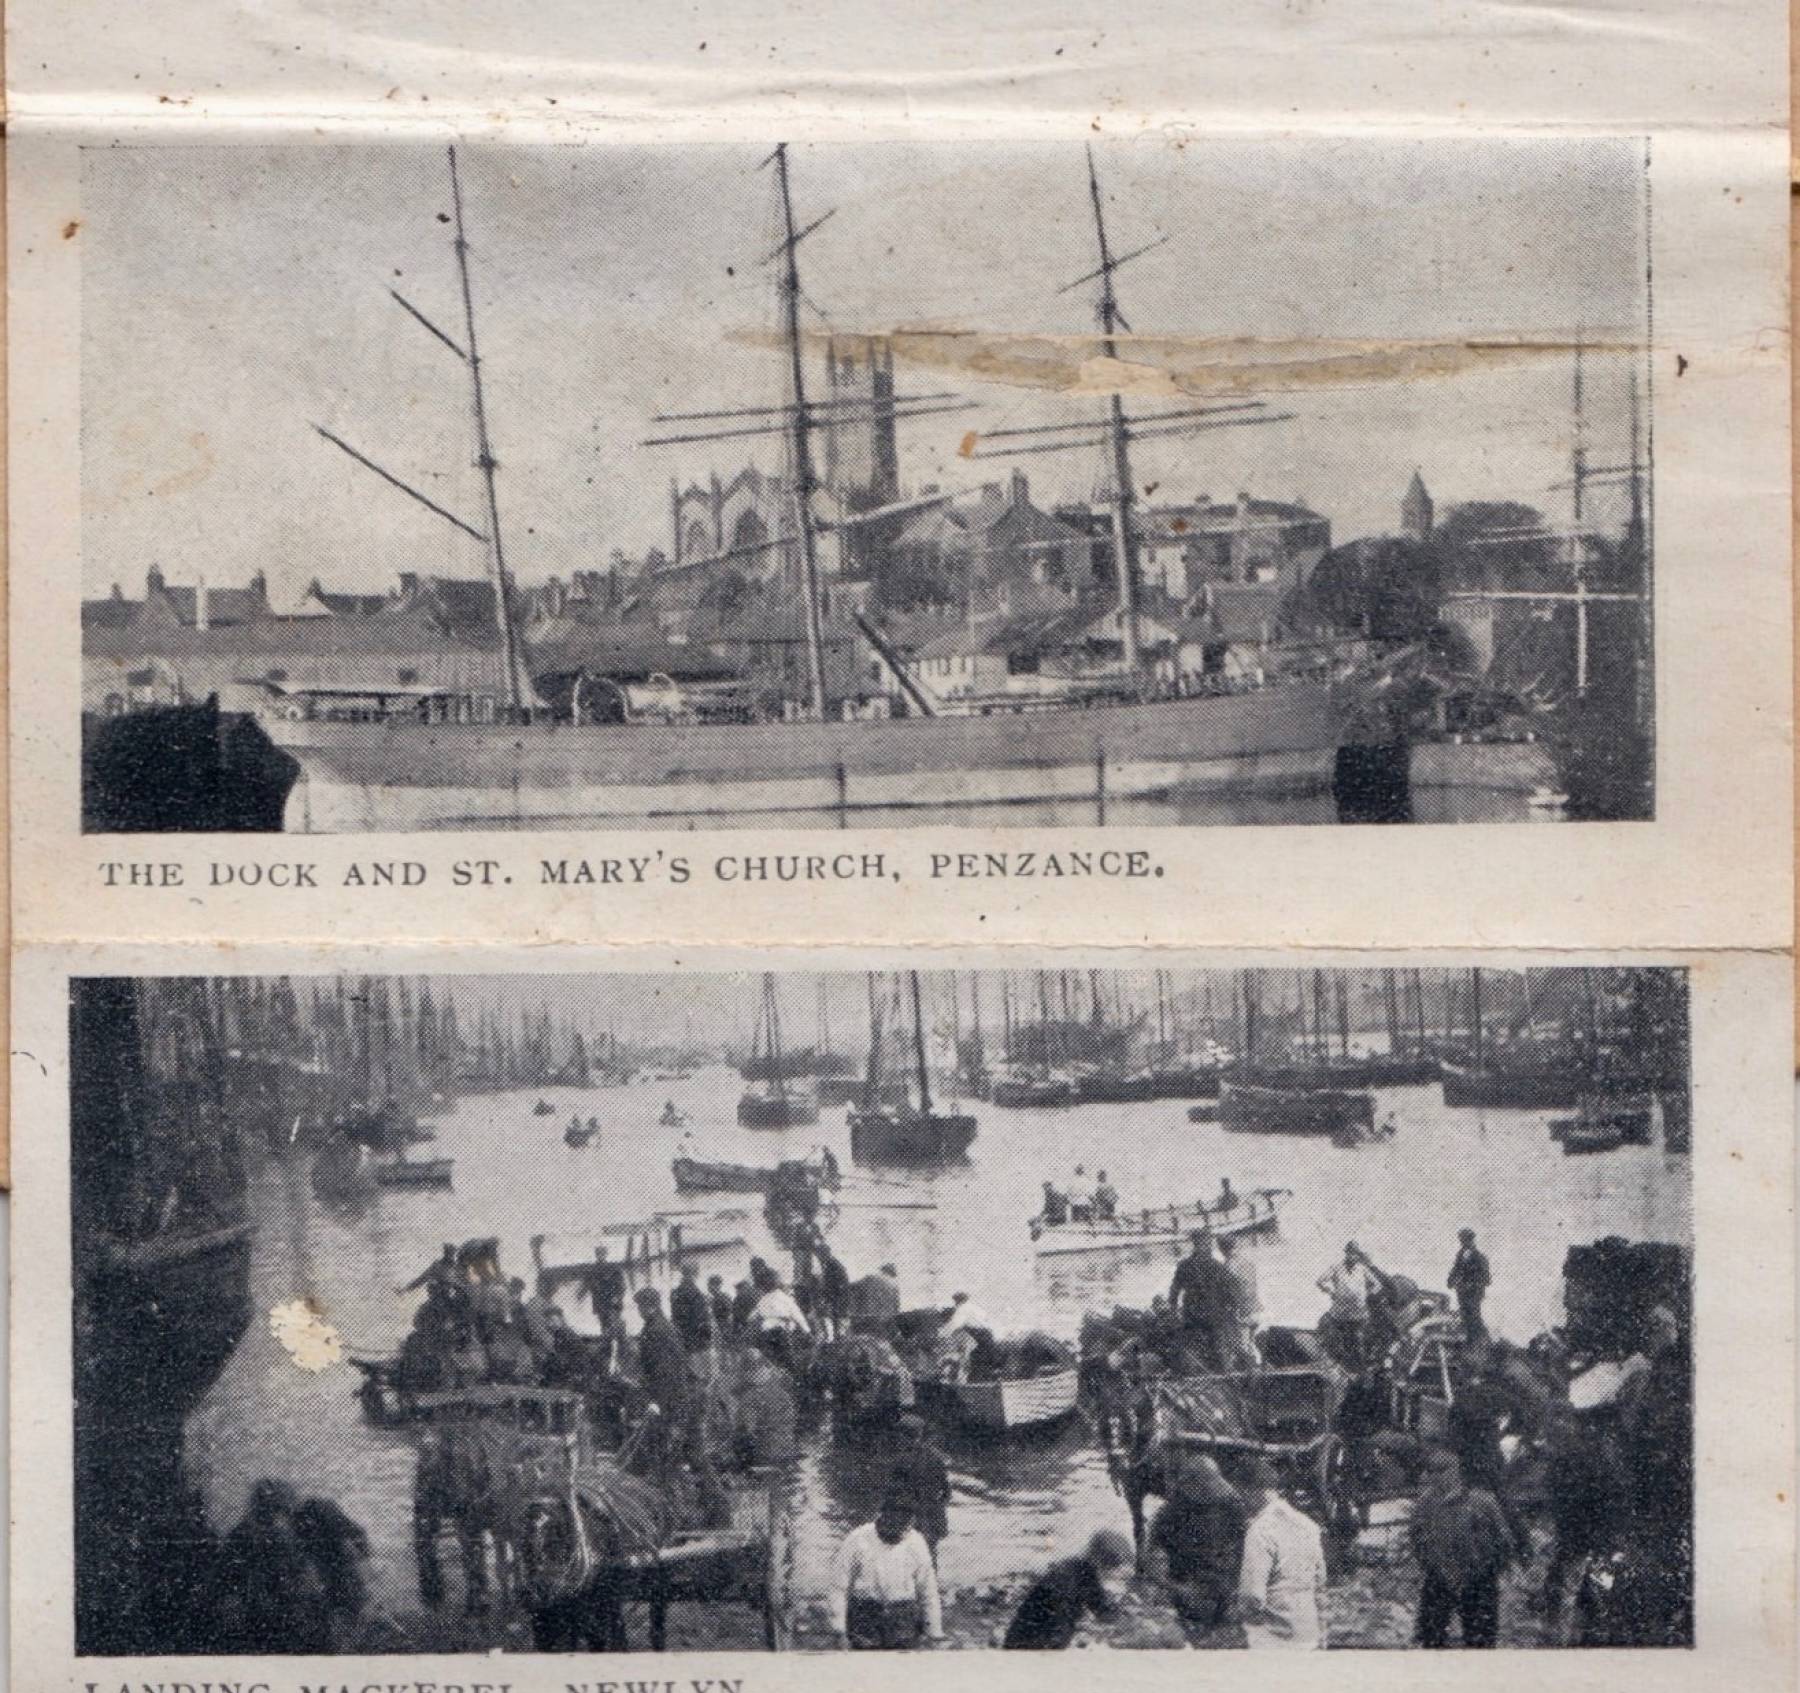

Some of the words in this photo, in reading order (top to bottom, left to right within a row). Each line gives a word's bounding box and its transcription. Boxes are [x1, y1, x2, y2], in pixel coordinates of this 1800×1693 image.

[98, 862, 185, 888] THE
[209, 862, 319, 888] DOCK
[342, 861, 428, 887] AND
[452, 860, 513, 887] ST.
[540, 849, 692, 885] MARY'S
[714, 853, 901, 884] CHURCH,
[930, 851, 1166, 880] PENZANCE.
